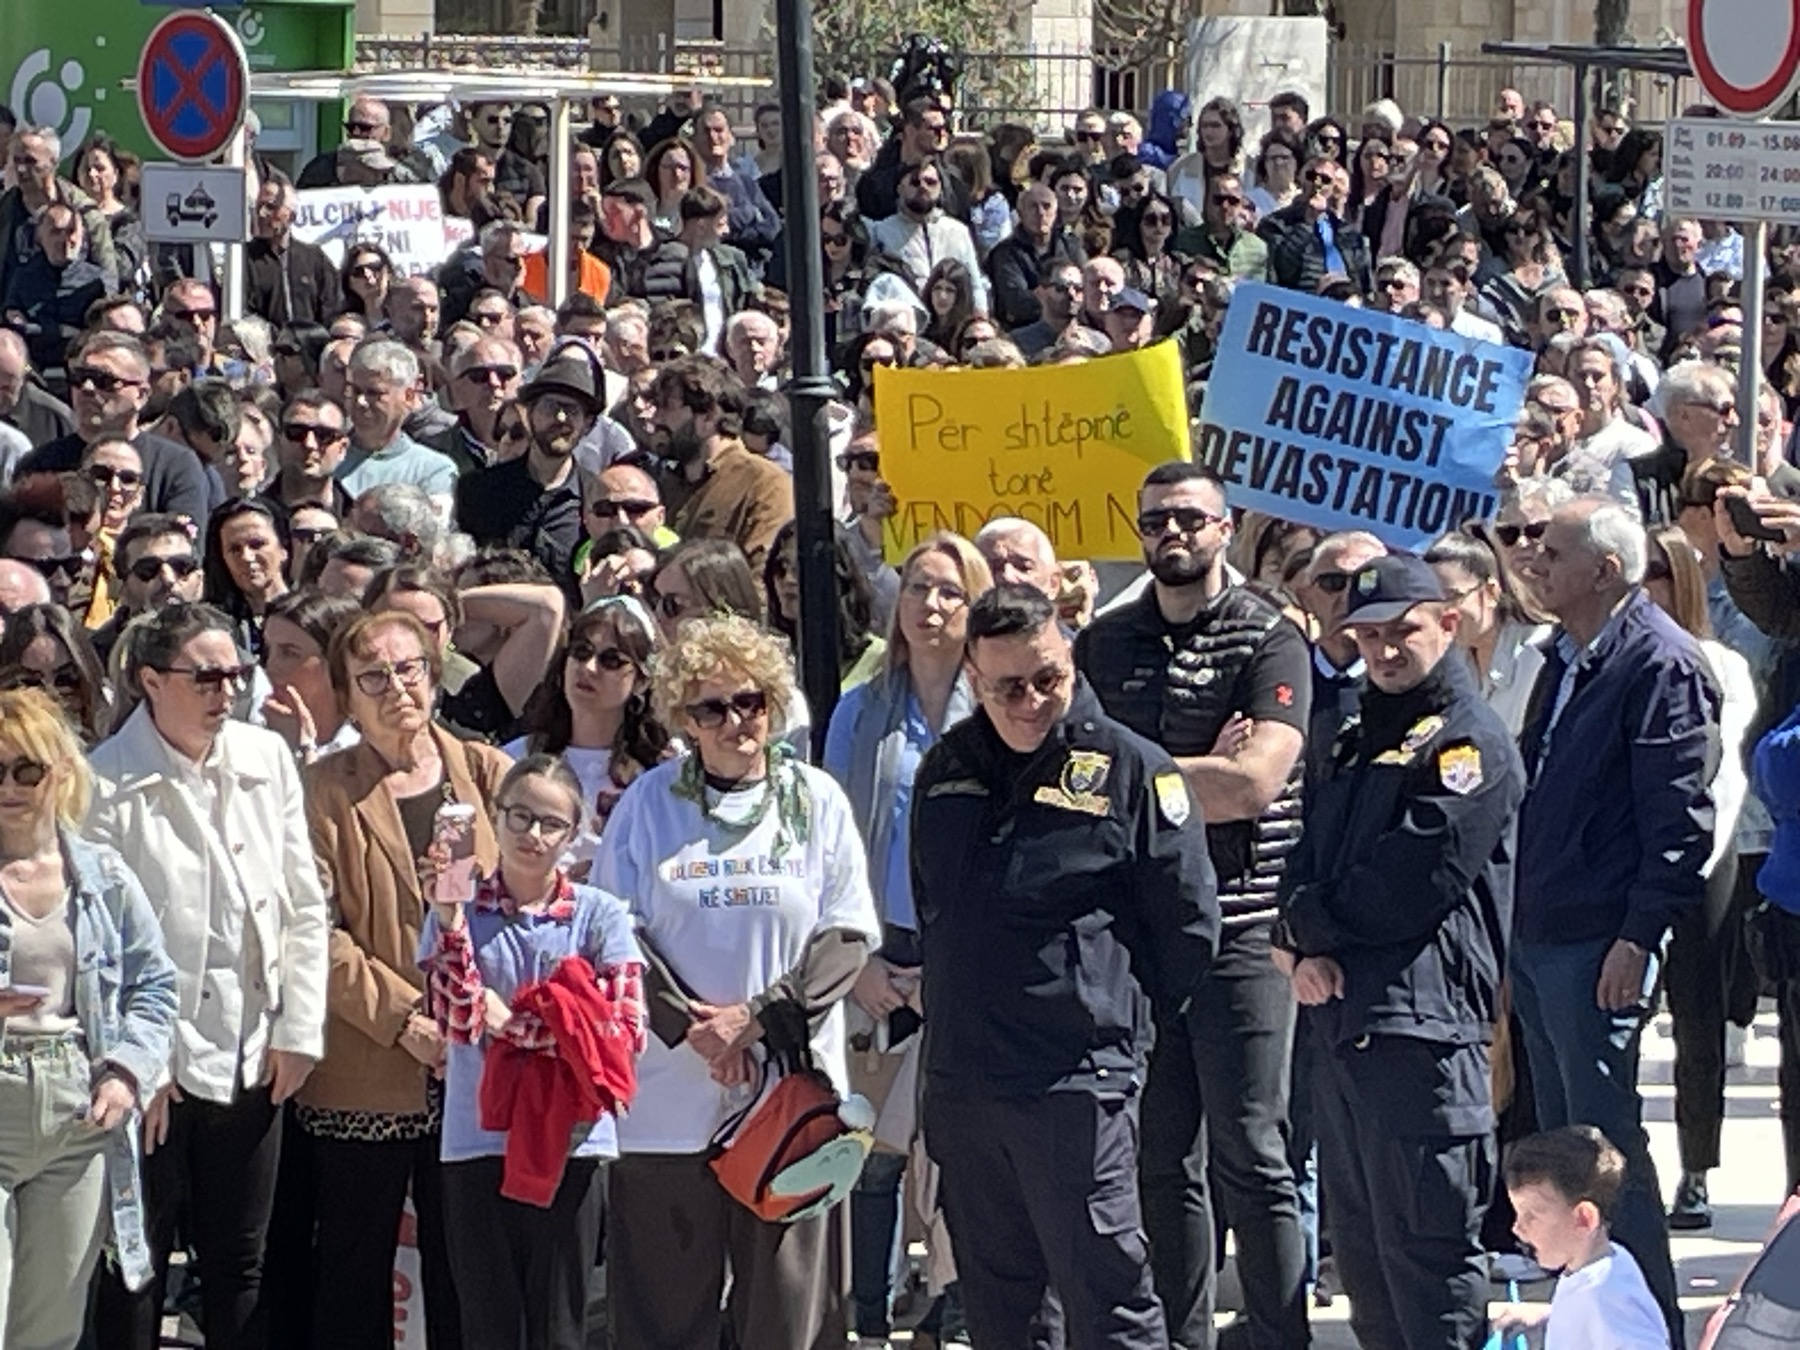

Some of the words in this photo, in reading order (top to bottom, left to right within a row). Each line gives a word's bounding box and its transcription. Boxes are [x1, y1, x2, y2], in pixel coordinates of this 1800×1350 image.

[387, 200, 439, 221] NIJE
[1246, 301, 1504, 414] RESISTANCE
[908, 393, 981, 451] Për
[1265, 376, 1453, 467] AGAINST
[1199, 424, 1496, 535] DEVASTATION!
